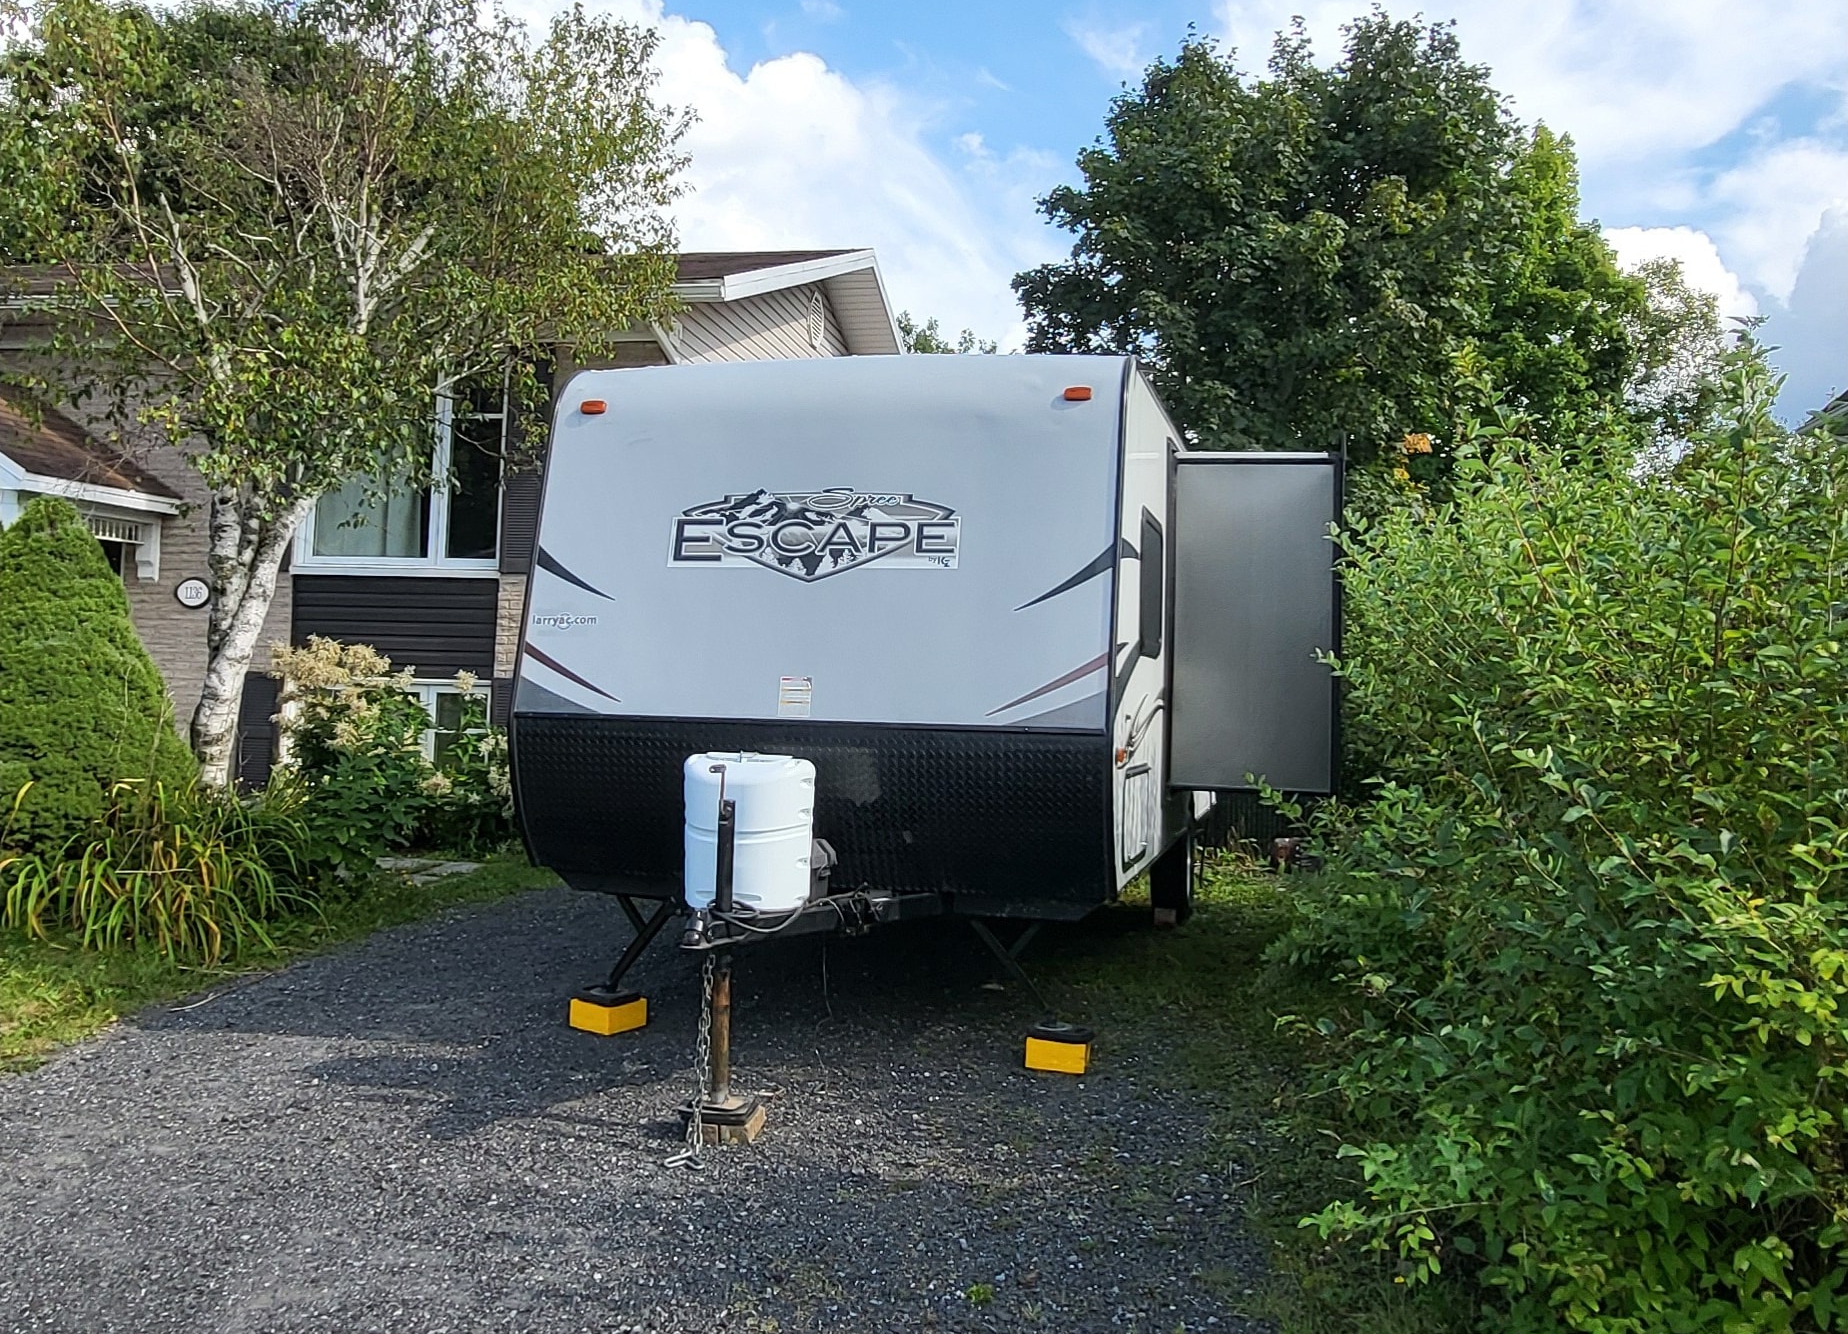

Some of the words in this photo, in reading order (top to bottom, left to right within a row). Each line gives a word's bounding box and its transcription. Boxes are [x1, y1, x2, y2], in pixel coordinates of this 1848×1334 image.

[808, 487, 899, 509] Spree
[672, 518, 956, 562] ESCAPE
[532, 614, 598, 627] larryac.com
